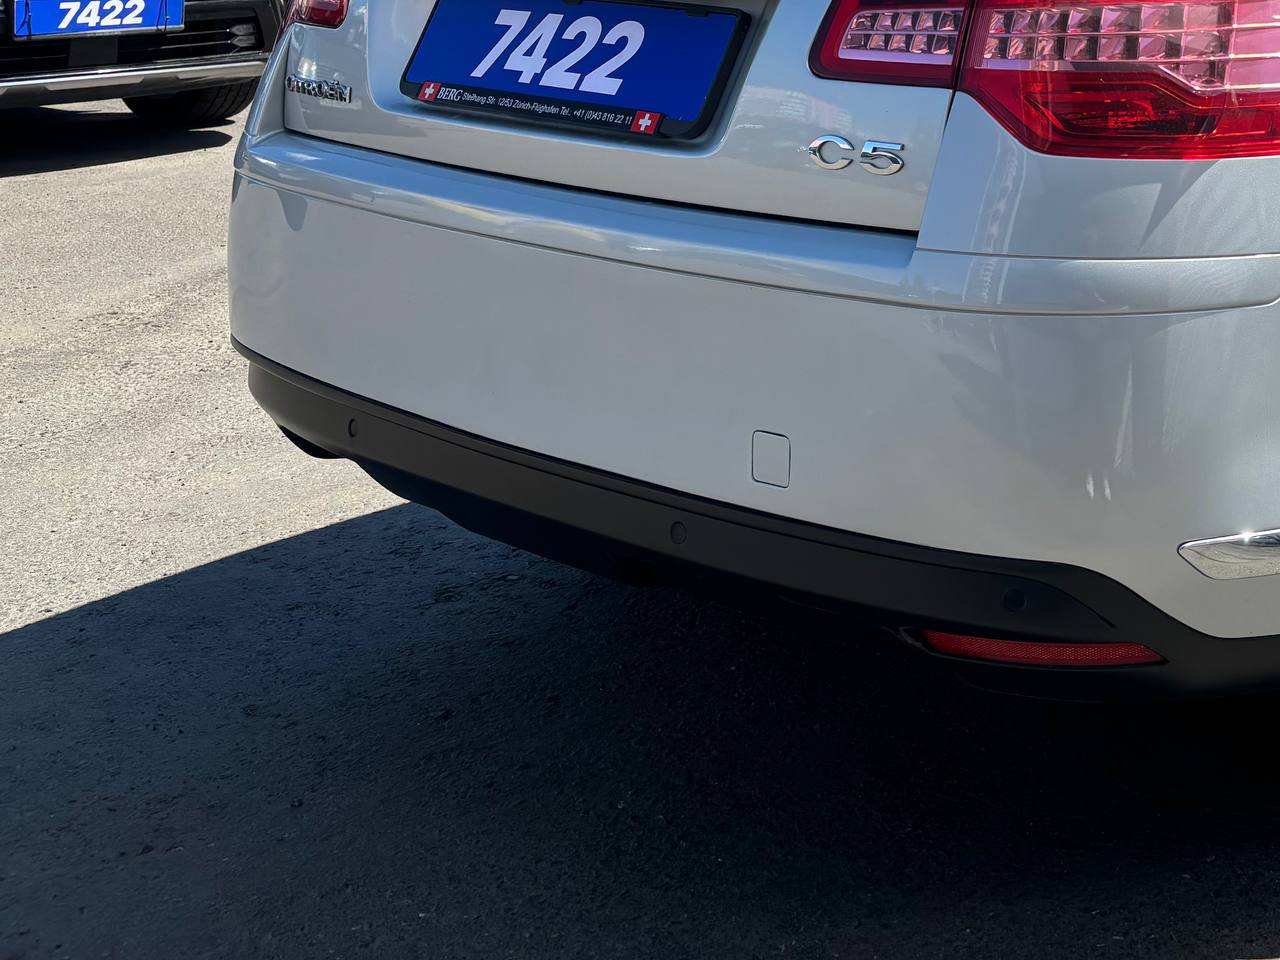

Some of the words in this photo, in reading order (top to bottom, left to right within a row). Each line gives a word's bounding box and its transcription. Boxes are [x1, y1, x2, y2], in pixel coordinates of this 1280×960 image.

[469, 8, 646, 96] 7422
[437, 87, 464, 101] BERG
[497, 97, 513, 107] 12/53
[573, 108, 584, 118] +41
[584, 110, 602, 120] (0)43
[602, 111, 614, 122] 816
[614, 114, 624, 124] 22
[625, 116, 633, 125] 11
[808, 134, 905, 177] C5
